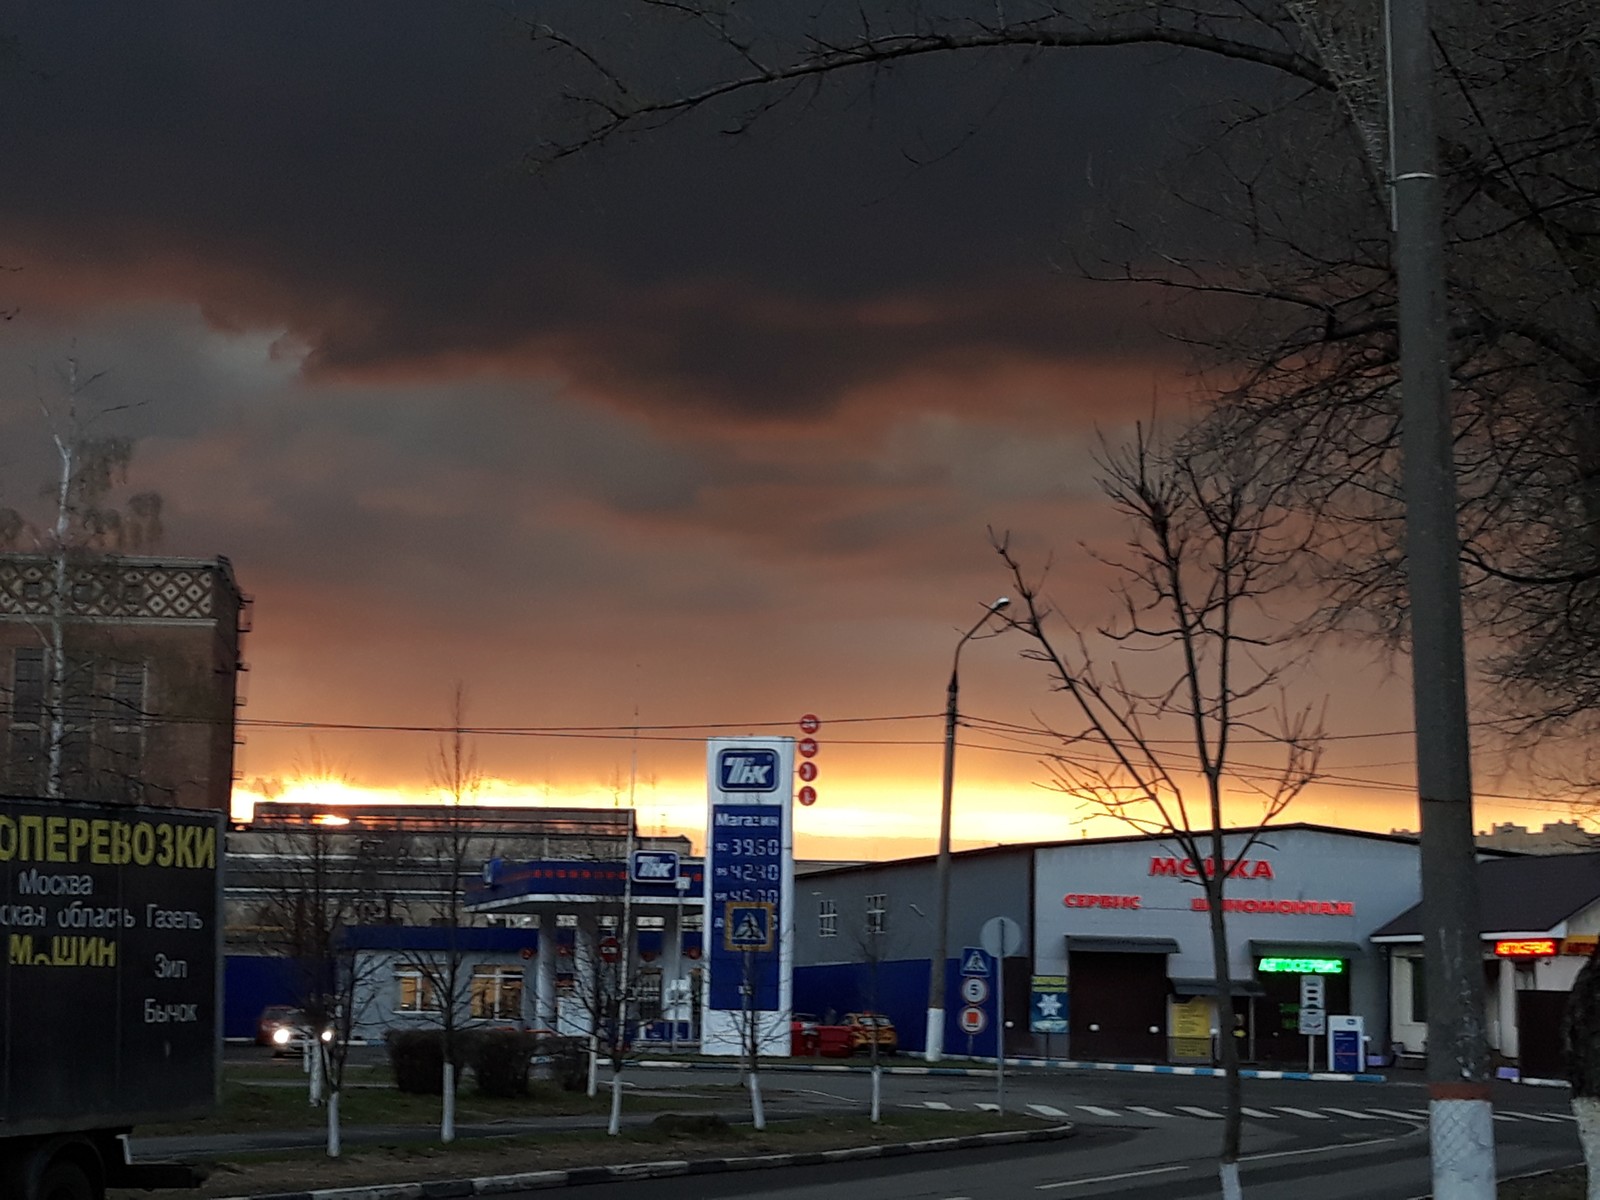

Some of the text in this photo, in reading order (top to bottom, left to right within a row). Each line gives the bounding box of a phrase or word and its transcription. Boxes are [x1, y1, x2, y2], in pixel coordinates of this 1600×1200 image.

[715, 813, 779, 827] Магазин
[0, 815, 216, 869] ОПЕРЕВОЗКИ
[18, 867, 93, 895] Москва
[1064, 893, 1141, 909] СЕРВИС
[1191, 898, 1354, 915] ШНОМОНТАЖ
[57, 901, 136, 928] область
[147, 904, 204, 929] Газель
[144, 998, 198, 1023] Бычок
